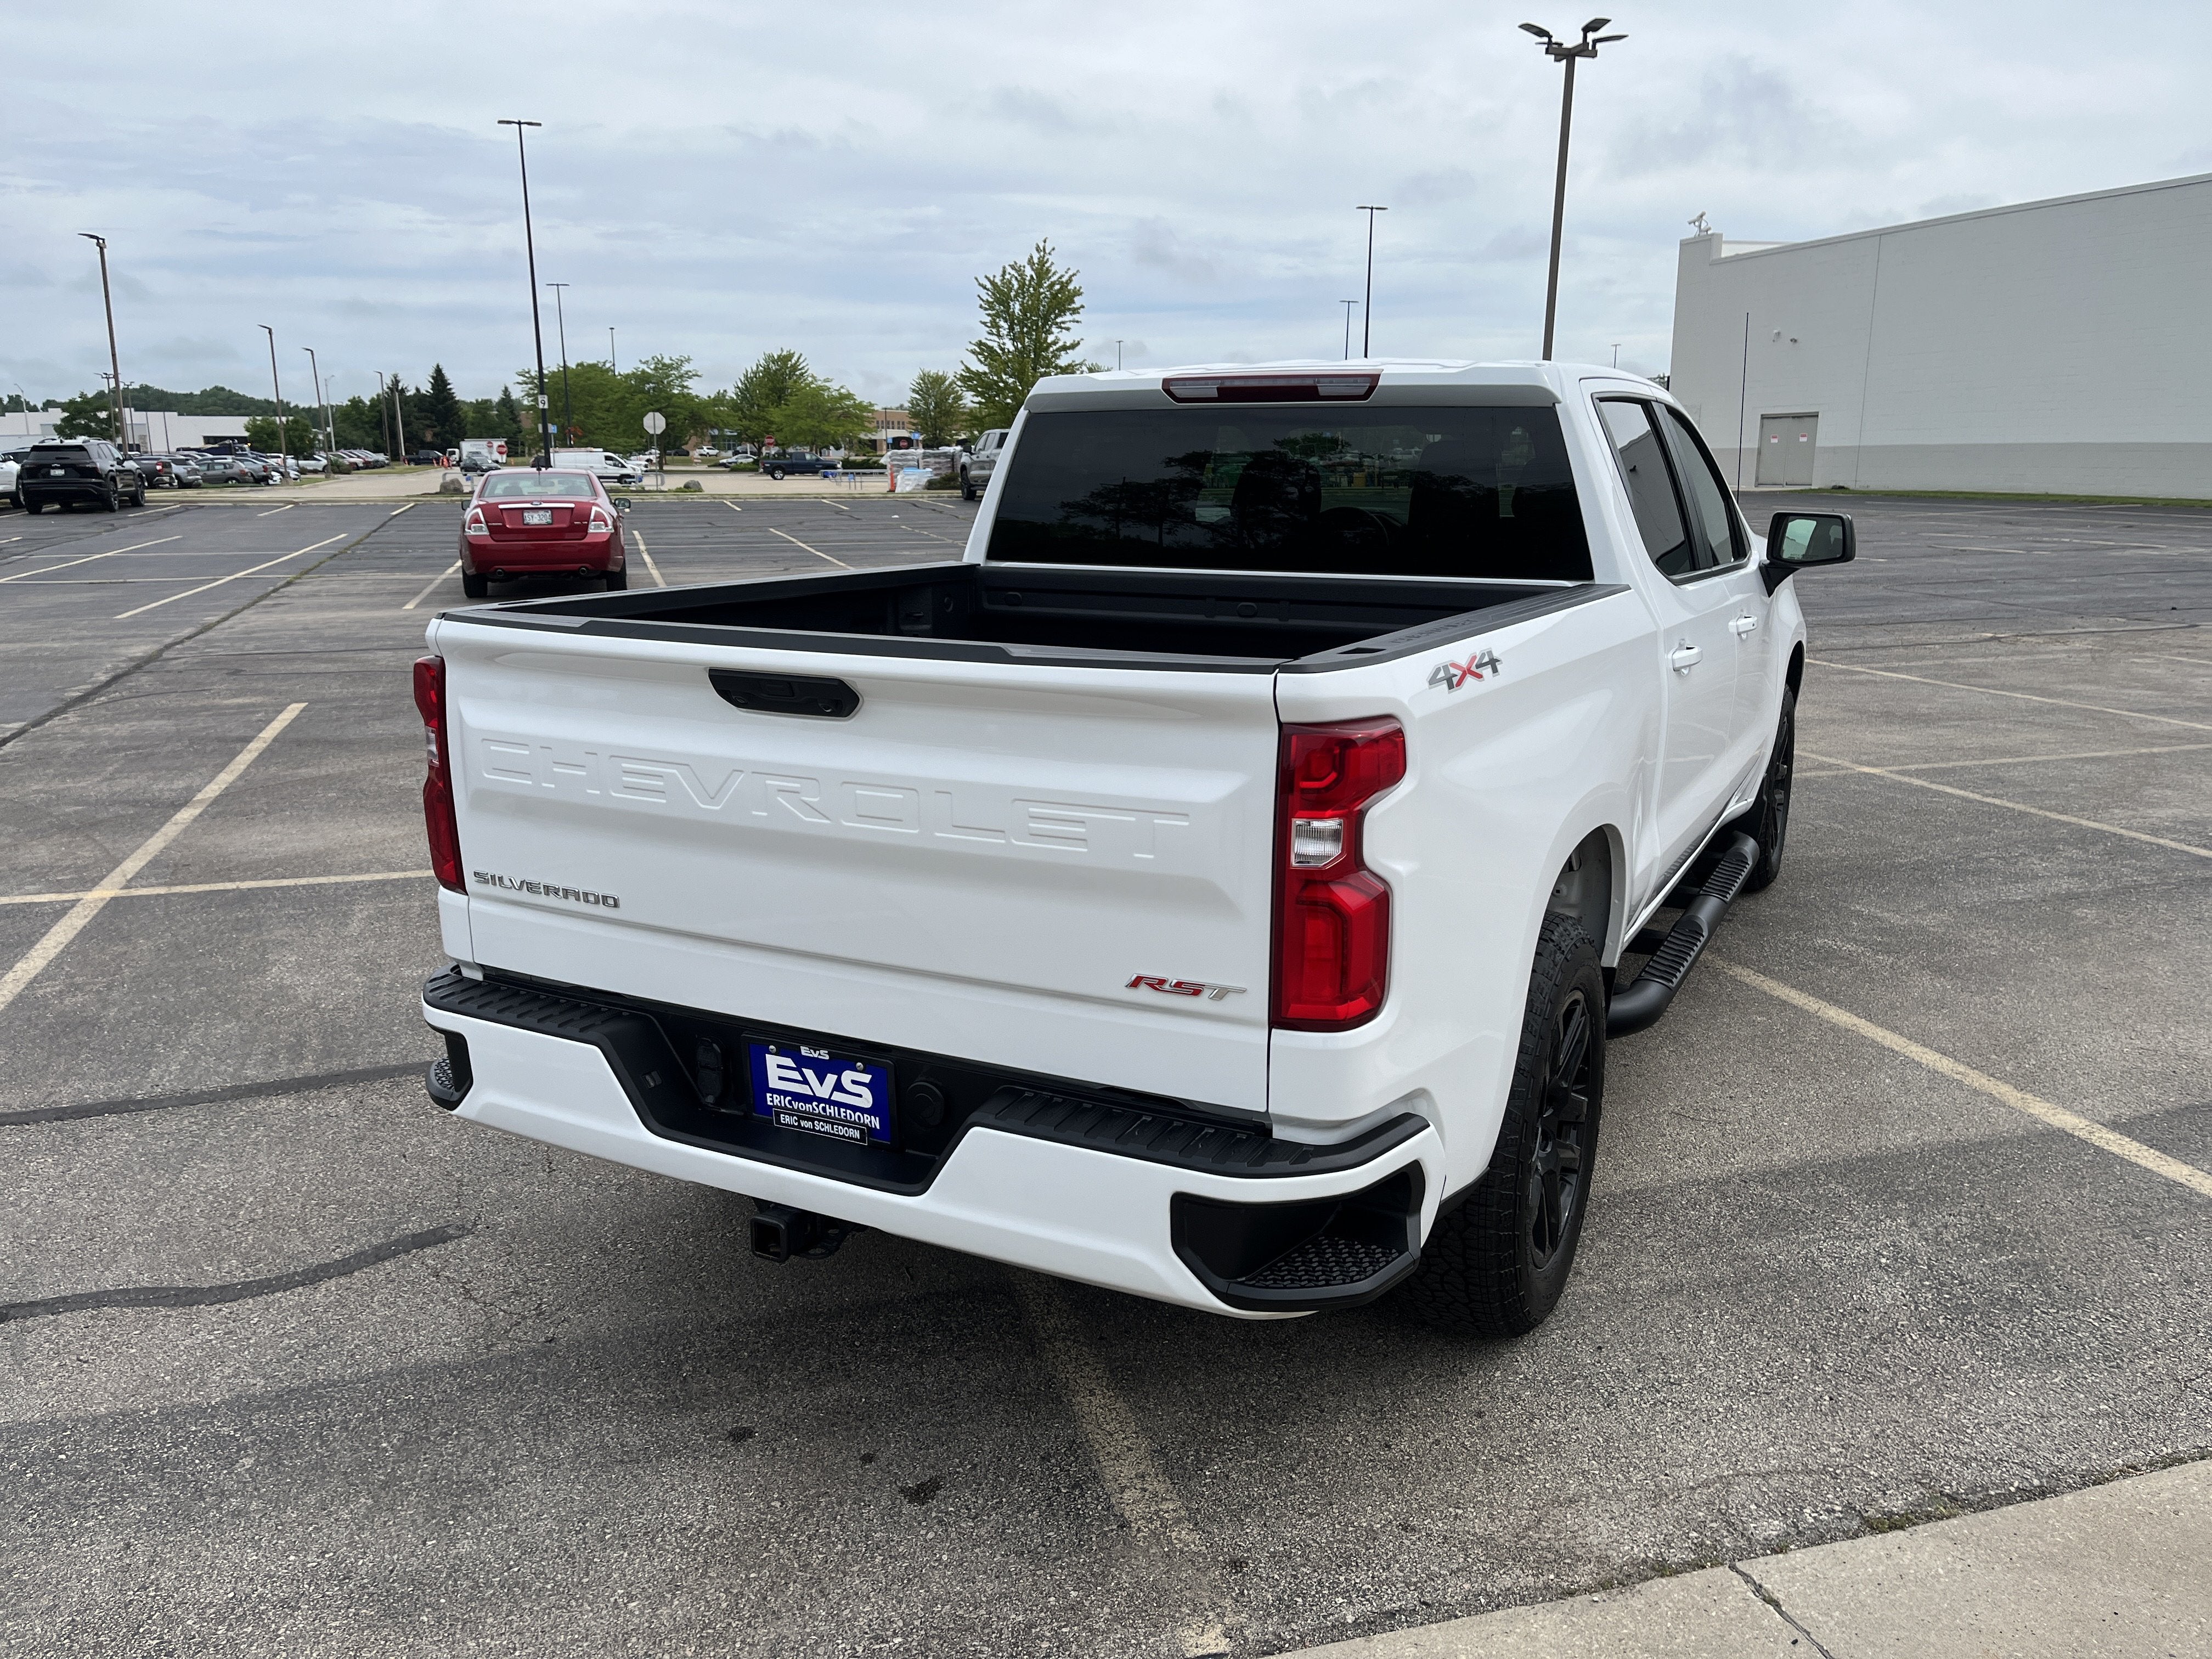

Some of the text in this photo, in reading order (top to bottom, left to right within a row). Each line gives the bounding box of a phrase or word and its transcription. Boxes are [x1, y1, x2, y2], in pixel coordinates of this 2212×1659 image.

[540, 399, 546, 408] 9
[482, 738, 1189, 858] CHEVROLET
[473, 869, 620, 909] SILVERADO
[1125, 973, 1247, 1001] RST
[780, 1114, 860, 1139] ERIC von SCHLEDORN
